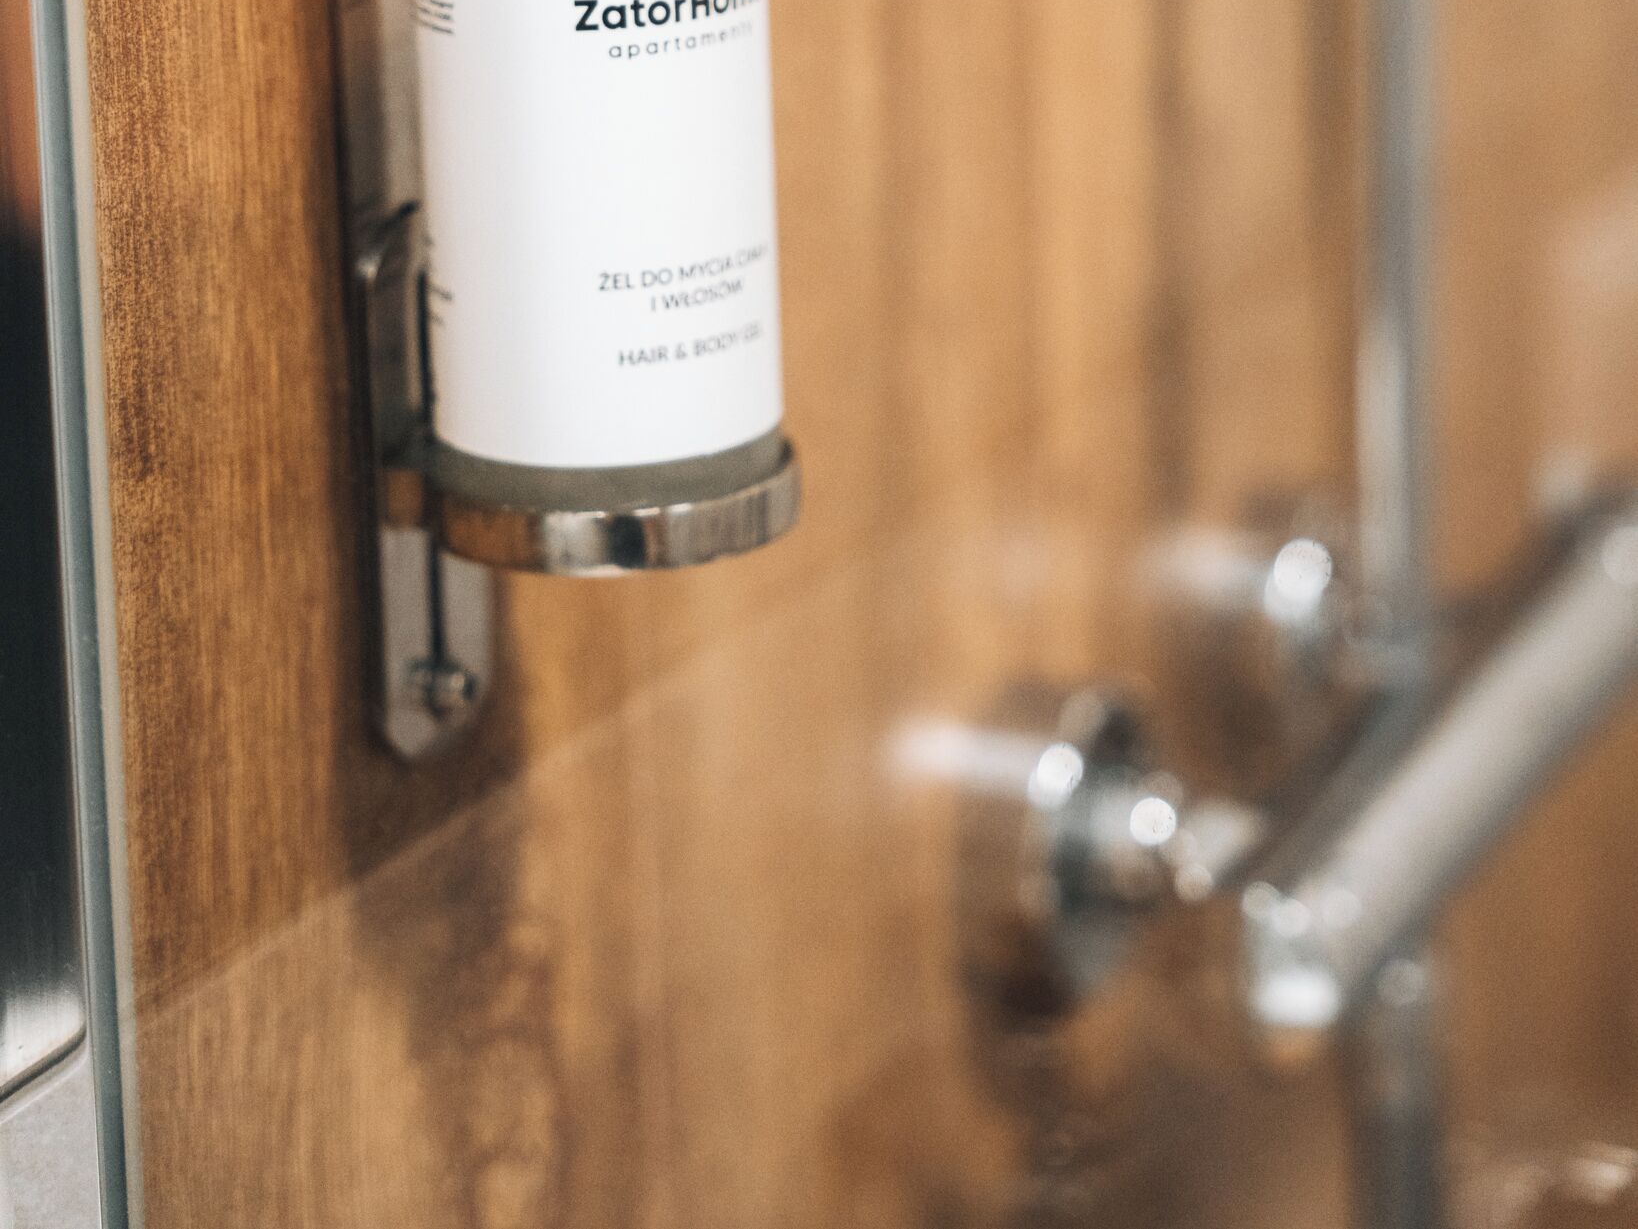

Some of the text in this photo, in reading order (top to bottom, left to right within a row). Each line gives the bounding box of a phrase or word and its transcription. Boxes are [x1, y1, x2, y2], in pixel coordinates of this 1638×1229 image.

[641, 267, 674, 288] DO
[650, 296, 657, 313] I
[618, 345, 668, 367] HAIR
[674, 342, 688, 360] &
[693, 330, 737, 357] BODY
